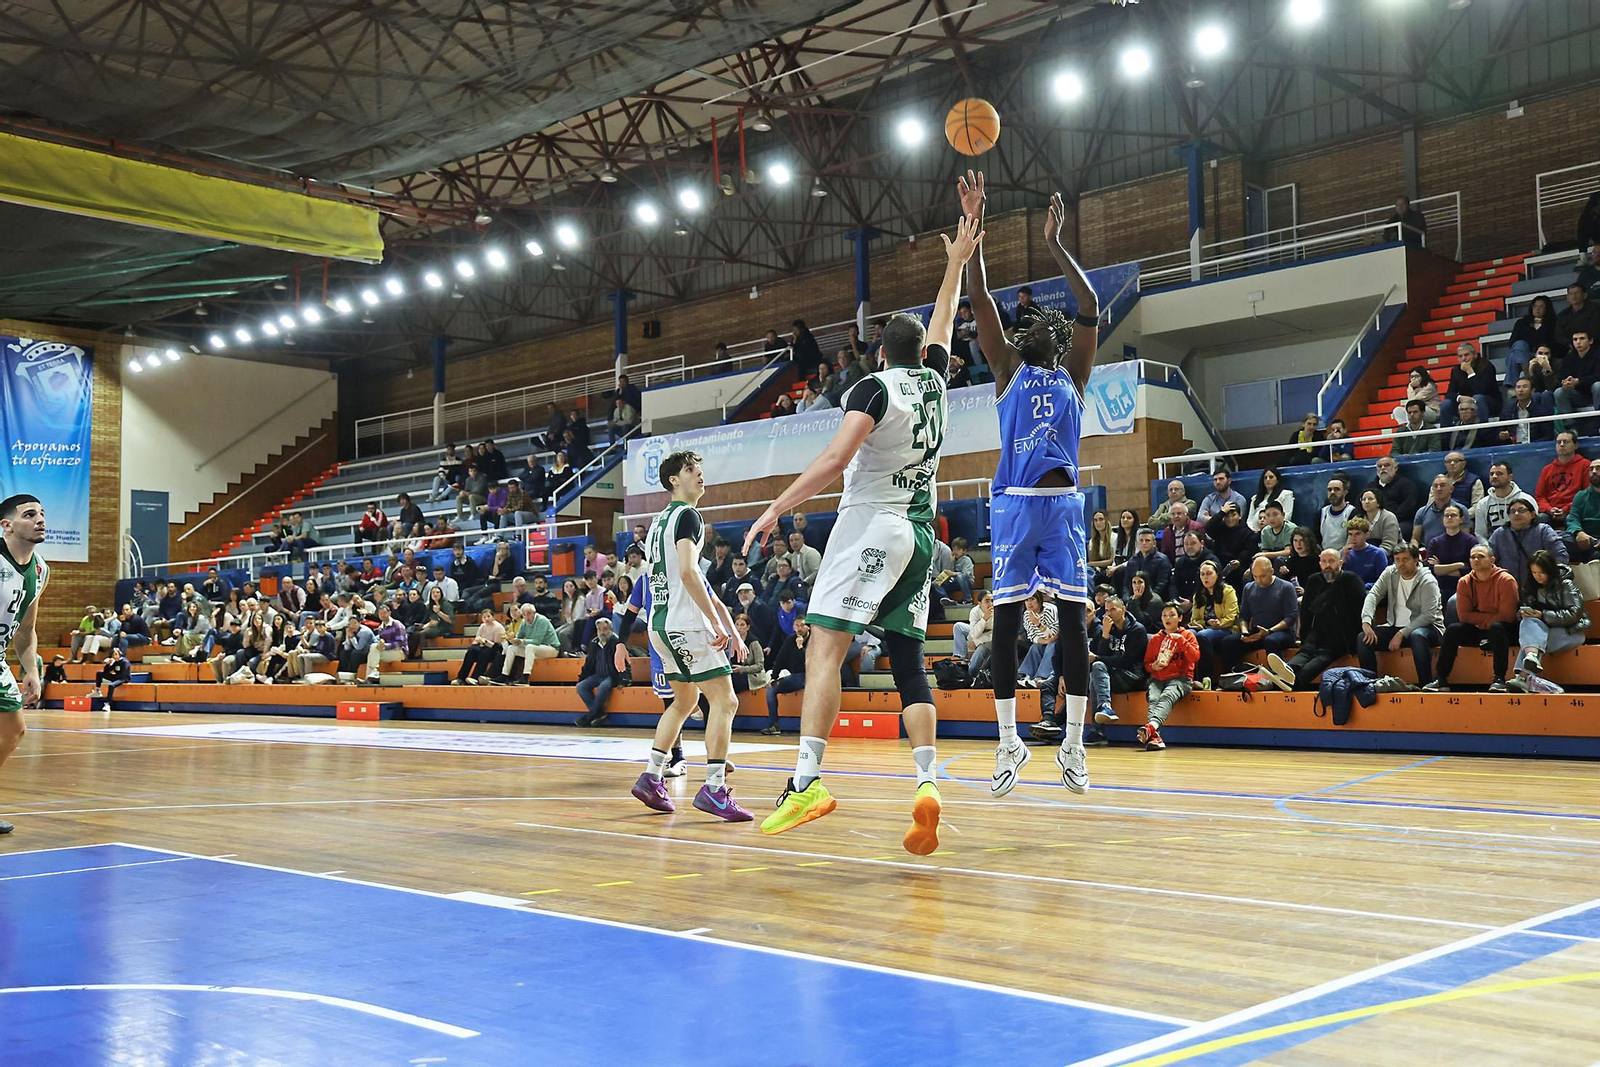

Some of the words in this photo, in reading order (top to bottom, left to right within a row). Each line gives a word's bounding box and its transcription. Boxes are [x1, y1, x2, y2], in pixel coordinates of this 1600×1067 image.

[1030, 393, 1055, 419] 25
[910, 402, 943, 451] 20
[11, 439, 82, 458] Apoyamos
[672, 429, 744, 450] Ayuntamiento
[12, 454, 27, 466] tu
[30, 452, 82, 472] esfuerzo
[842, 595, 880, 611] efficold
[654, 672, 666, 687] 40
[1389, 696, 1402, 704] 40
[1447, 697, 1460, 705] 42
[1570, 698, 1584, 706] 46
